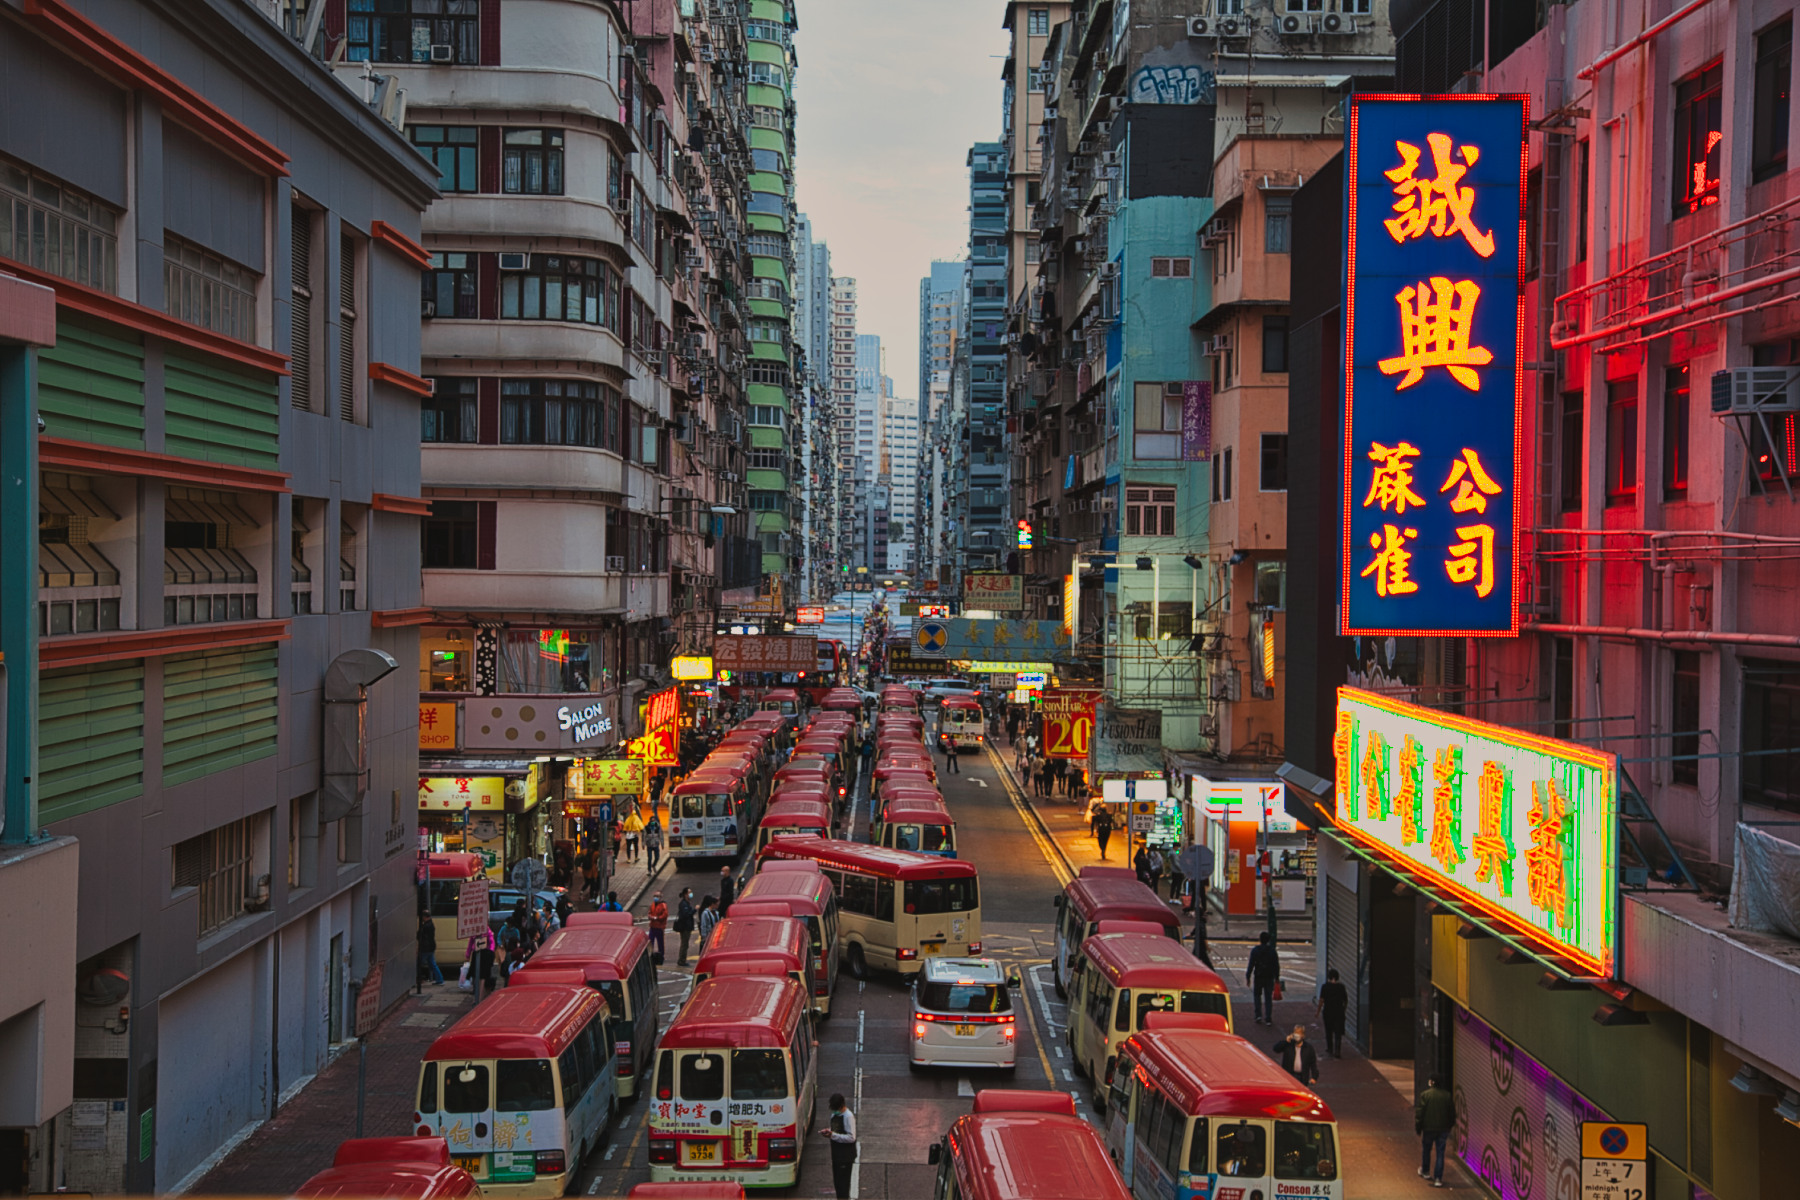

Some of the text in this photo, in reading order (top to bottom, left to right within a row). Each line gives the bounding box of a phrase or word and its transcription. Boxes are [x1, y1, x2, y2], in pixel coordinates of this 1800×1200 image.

[1378, 133, 1495, 391] 誠興
[1440, 448, 1502, 598] 公司
[575, 717, 612, 743] MORE
[1050, 717, 1090, 754] 20
[420, 735, 450, 744] SHOP
[587, 764, 641, 781] 海天堂
[658, 1102, 707, 1119] 寶和堂
[729, 1103, 766, 1115] 增肥丸
[691, 1151, 713, 1159] 3738
[1592, 1167, 1612, 1177] 上午
[1623, 1163, 1633, 1178] 7
[1277, 1183, 1311, 1194] Conson
[1585, 1184, 1619, 1192] midnight
[1624, 1187, 1643, 1200] 12
